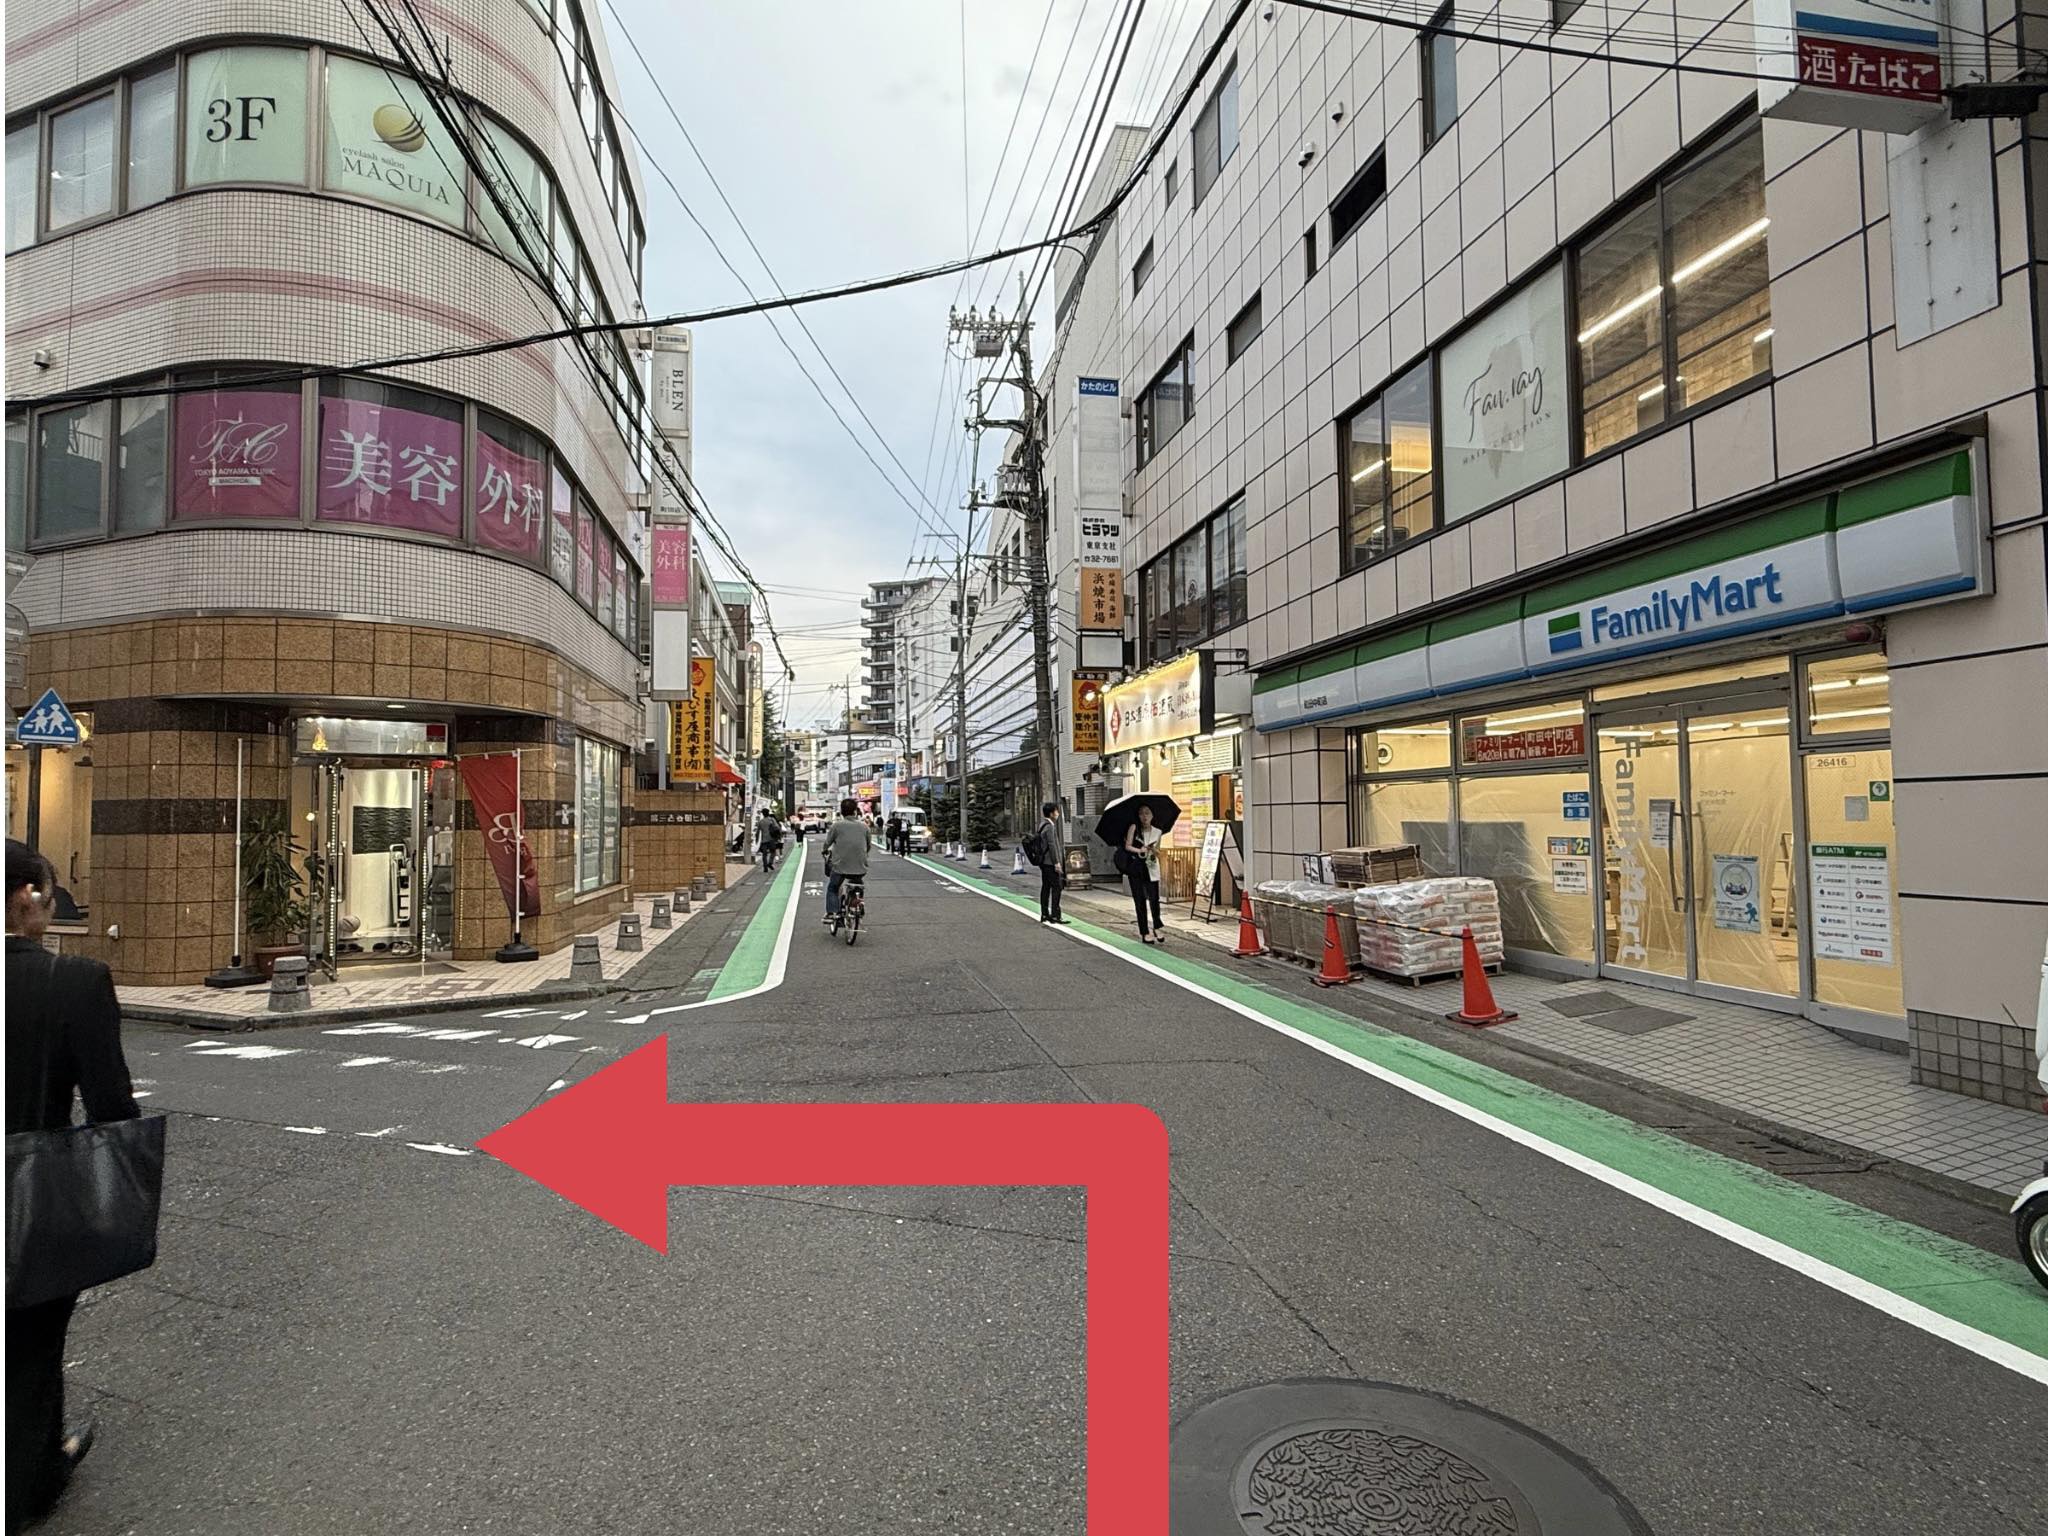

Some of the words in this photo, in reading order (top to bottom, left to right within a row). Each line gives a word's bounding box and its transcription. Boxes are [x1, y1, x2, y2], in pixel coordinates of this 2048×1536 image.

[206, 96, 276, 142] 3F
[342, 155, 450, 206] MAQUIA
[380, 156, 405, 170] salon
[671, 368, 684, 412] BLEN
[1080, 382, 1117, 393] かたのビル
[325, 429, 459, 506] 美容
[478, 462, 545, 541] 外科
[1082, 523, 1120, 537] ヒラマツ
[1086, 541, 1116, 550] 東京支社
[1092, 572, 1105, 624] 浜焼市場
[1590, 562, 1783, 644] FamilyMart
[1817, 757, 1848, 767] 26416
